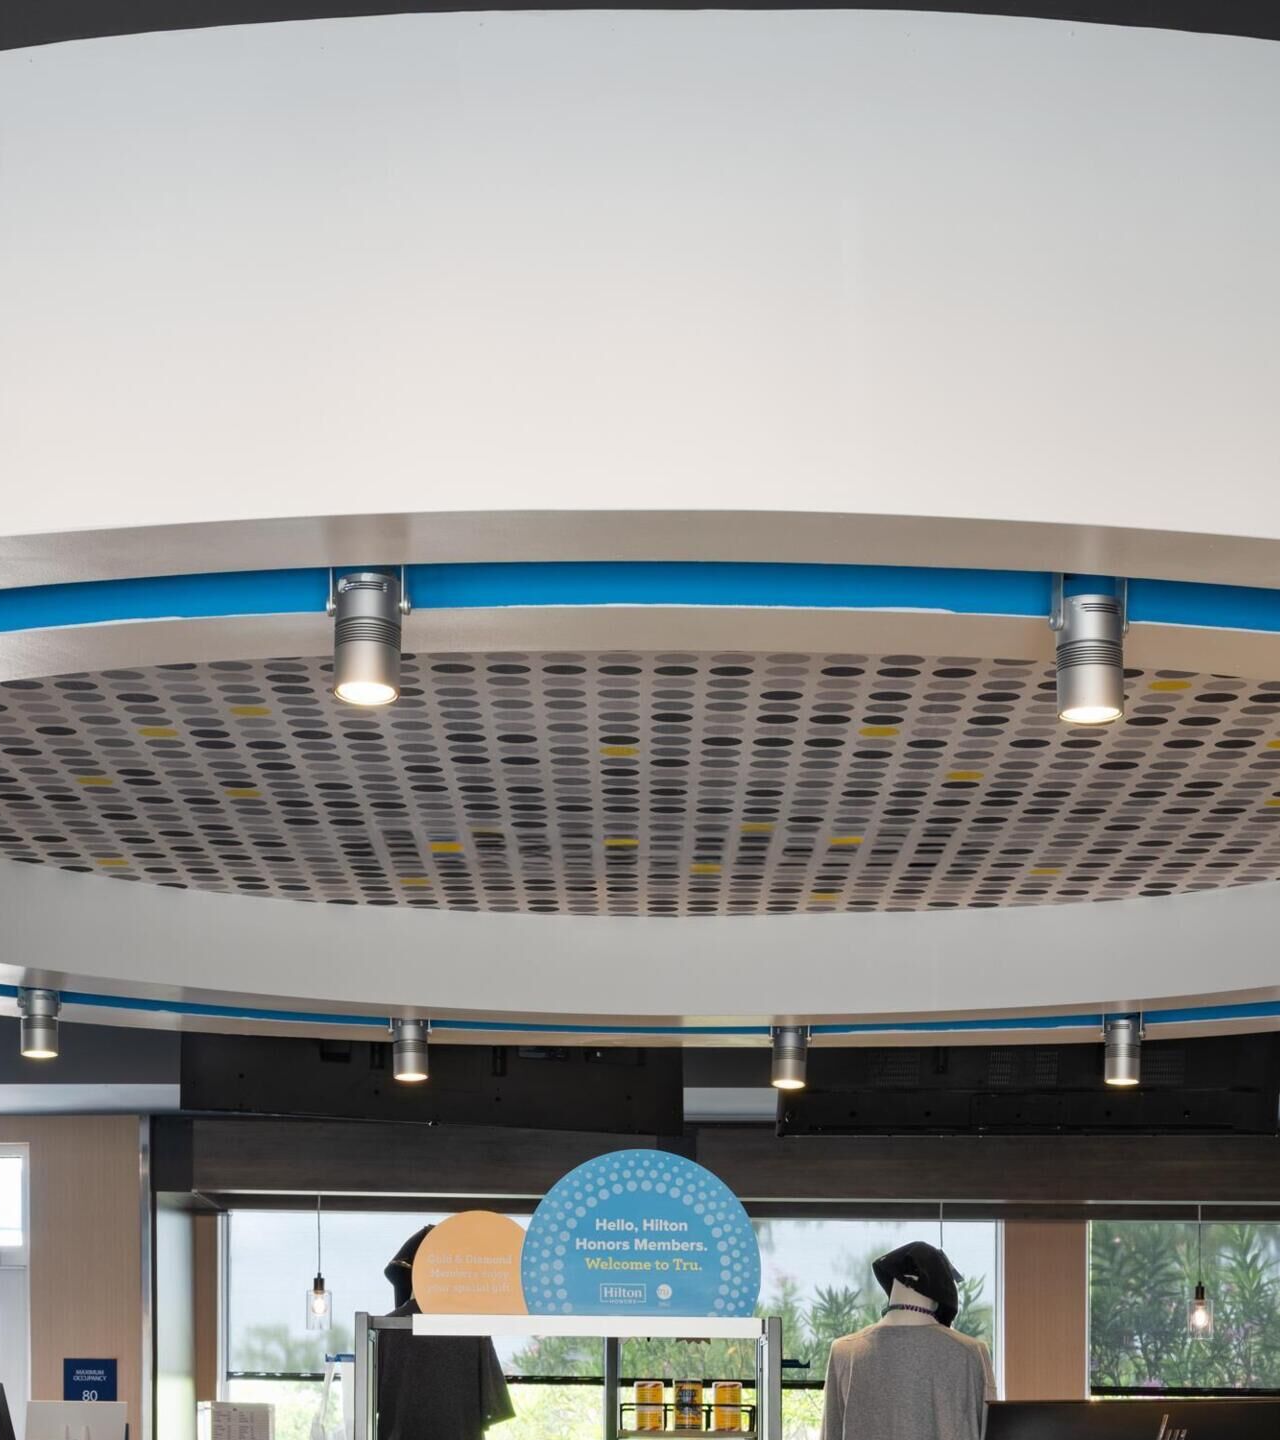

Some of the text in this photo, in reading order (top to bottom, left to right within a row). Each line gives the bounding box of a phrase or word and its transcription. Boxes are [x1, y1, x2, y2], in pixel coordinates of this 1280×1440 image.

[595, 1218, 688, 1232] Hello, Hilton
[575, 1238, 708, 1251] Honors Members.
[585, 1257, 703, 1271] Welcome to Tru.
[603, 1286, 642, 1298] Hilton
[81, 1390, 99, 1402] 80
